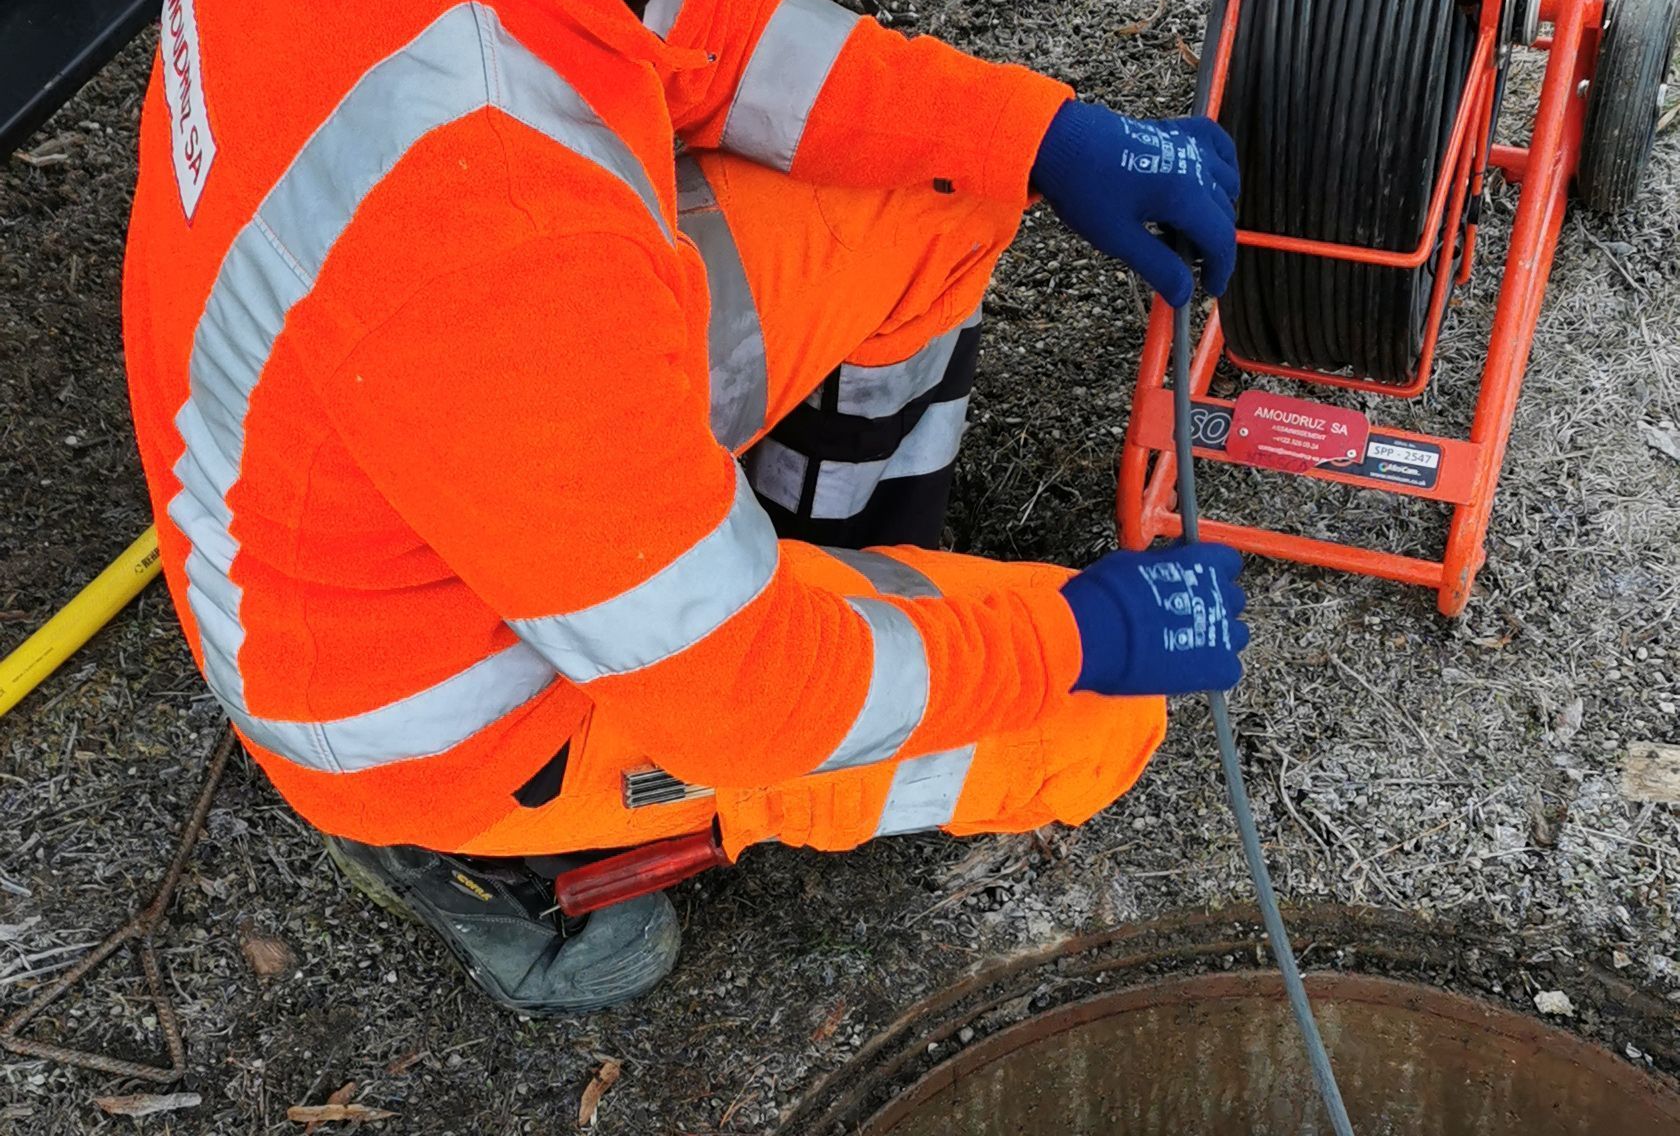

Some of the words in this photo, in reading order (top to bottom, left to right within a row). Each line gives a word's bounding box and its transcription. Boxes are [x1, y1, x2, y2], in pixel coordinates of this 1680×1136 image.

[185, 125, 203, 185] SA
[1254, 406, 1326, 431] AMOUDRUZ
[1331, 422, 1348, 436] SA
[1374, 445, 1394, 457] SPP
[1404, 451, 1432, 464] 2547
